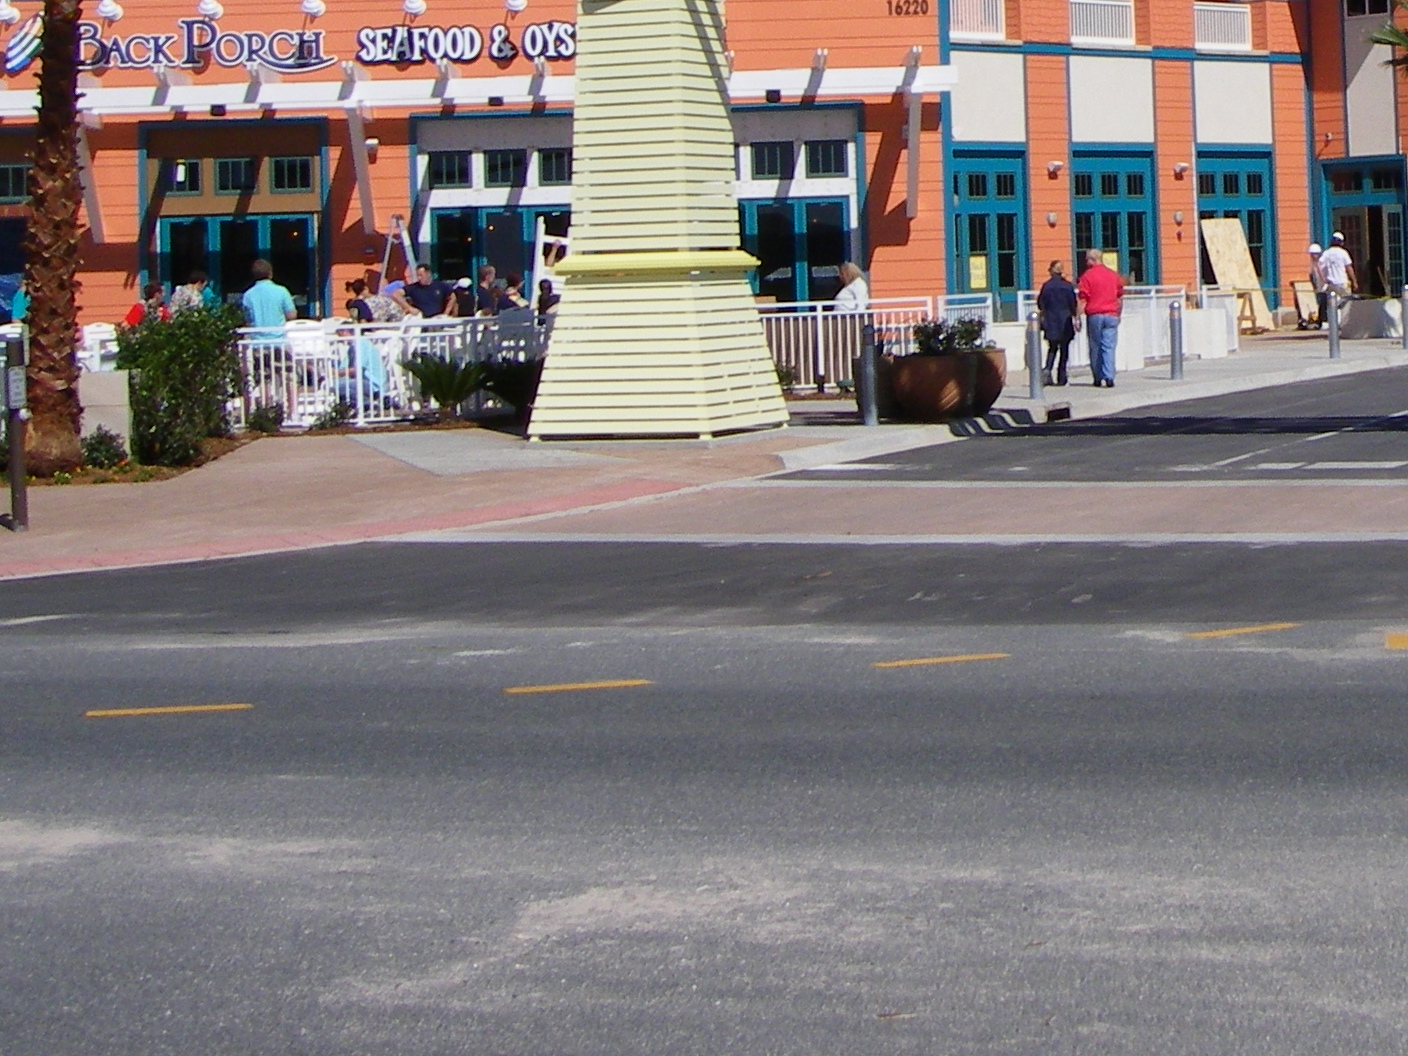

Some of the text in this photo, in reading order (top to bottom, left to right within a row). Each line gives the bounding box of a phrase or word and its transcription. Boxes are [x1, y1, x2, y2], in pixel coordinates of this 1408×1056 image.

[886, 0, 929, 16] 16220
[178, 17, 336, 72] PORCH
[357, 21, 577, 62] SEAFOOD & OYS
